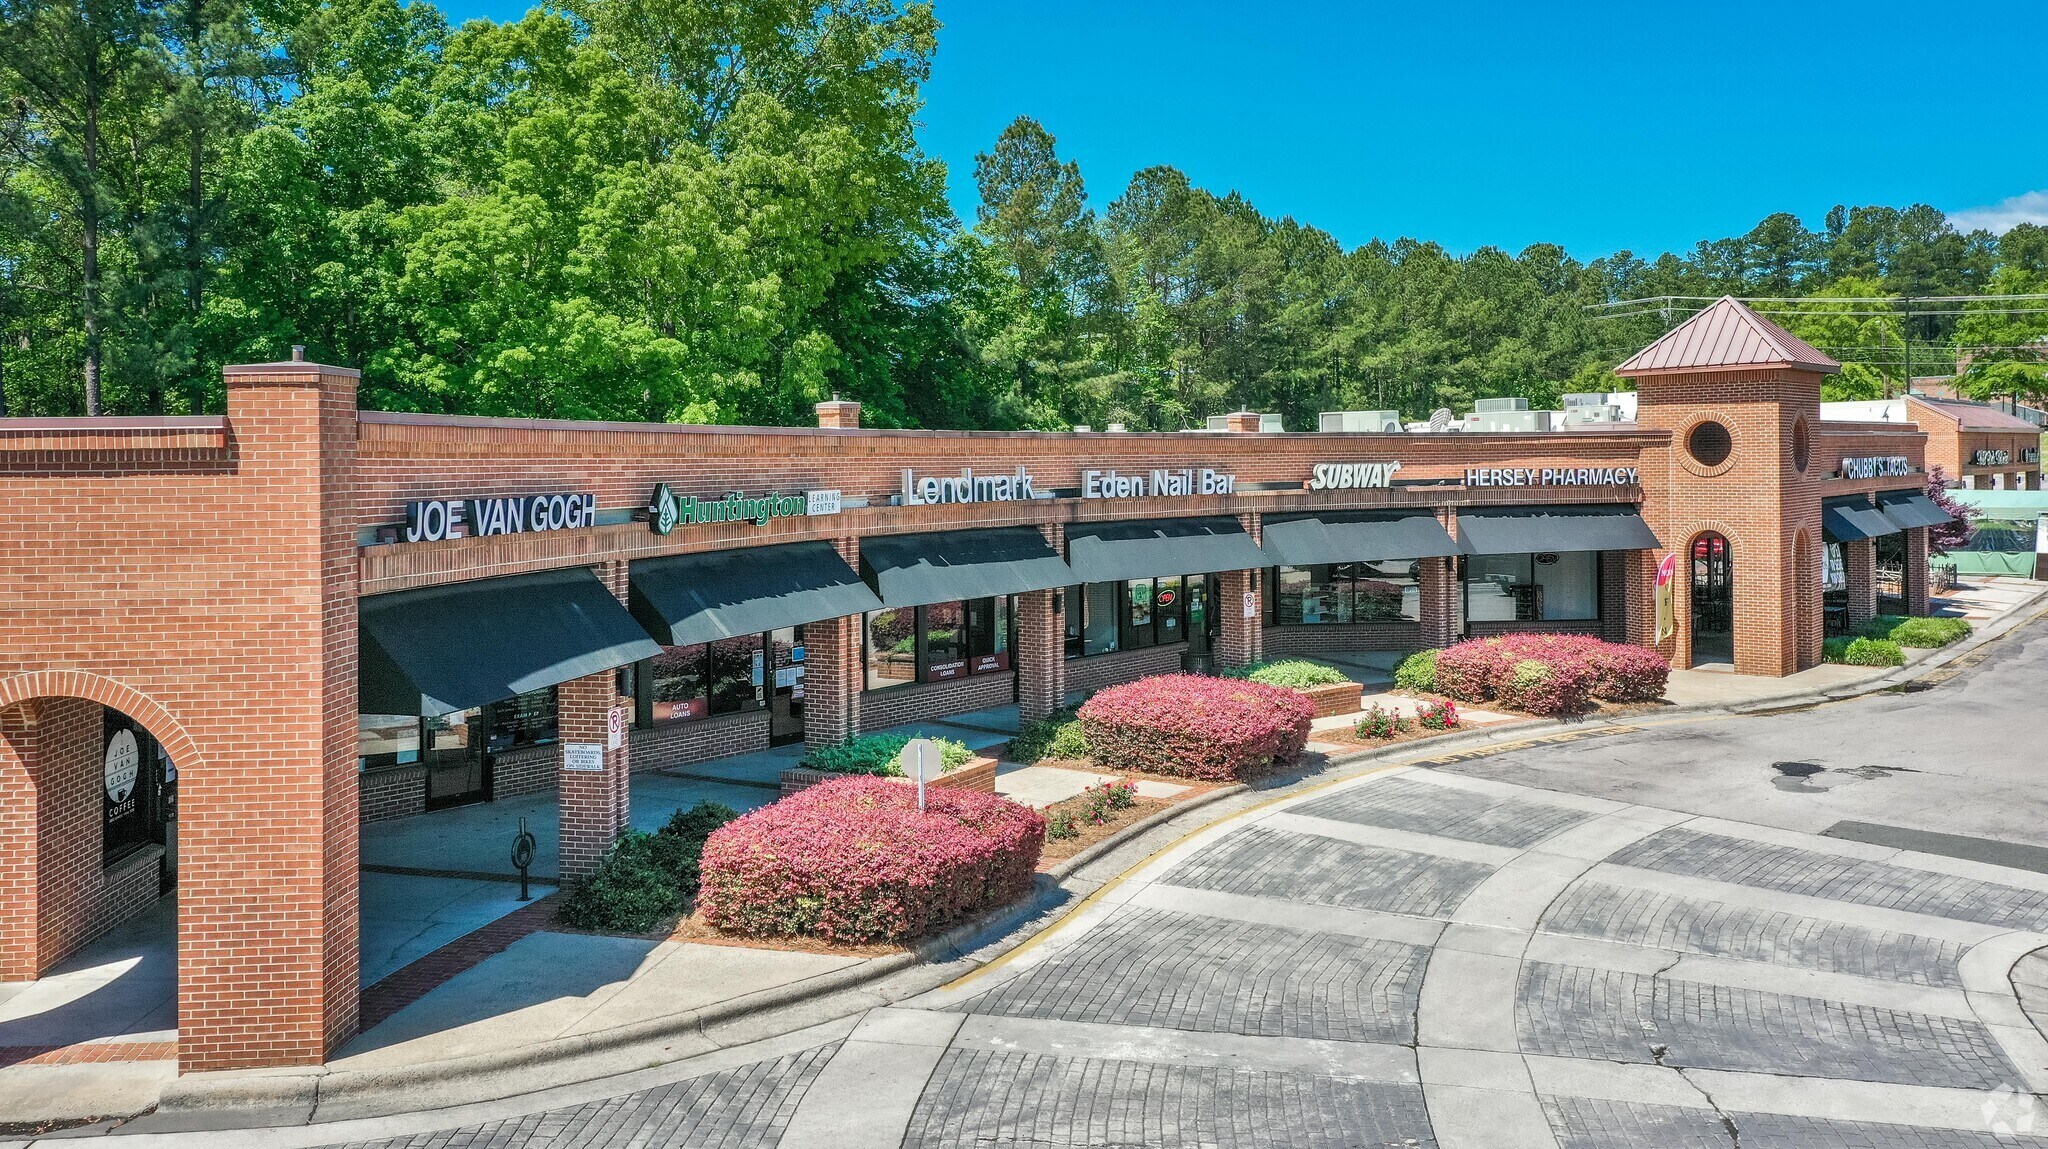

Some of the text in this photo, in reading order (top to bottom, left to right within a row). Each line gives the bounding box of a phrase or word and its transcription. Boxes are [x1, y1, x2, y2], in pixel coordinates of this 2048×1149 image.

[1848, 456, 1908, 479] CHUBBY'S TACOS
[1309, 461, 1402, 490] SUBWAY
[1466, 467, 1638, 486] HERSEY PHARMACY
[902, 466, 1036, 505] Lendmark
[1084, 468, 1236, 499] Eden Nail Bar
[808, 491, 841, 504] LEARNING
[678, 490, 806, 528] Huntington
[811, 501, 837, 513] CENTER
[406, 493, 597, 543] JOE VAN GOGH
[1158, 592, 1174, 603] OPEN
[981, 656, 996, 664] QUICK
[930, 661, 965, 672] CONSOLIDATION
[977, 662, 1000, 671] APPROVAL
[939, 669, 955, 677] LOANS
[672, 703, 689, 712] AUTO
[670, 710, 691, 719] LOANS
[114, 745, 130, 757] JOE
[114, 758, 130, 770] VAN
[111, 770, 134, 785] GOGH
[109, 799, 135, 817] COFFEE
